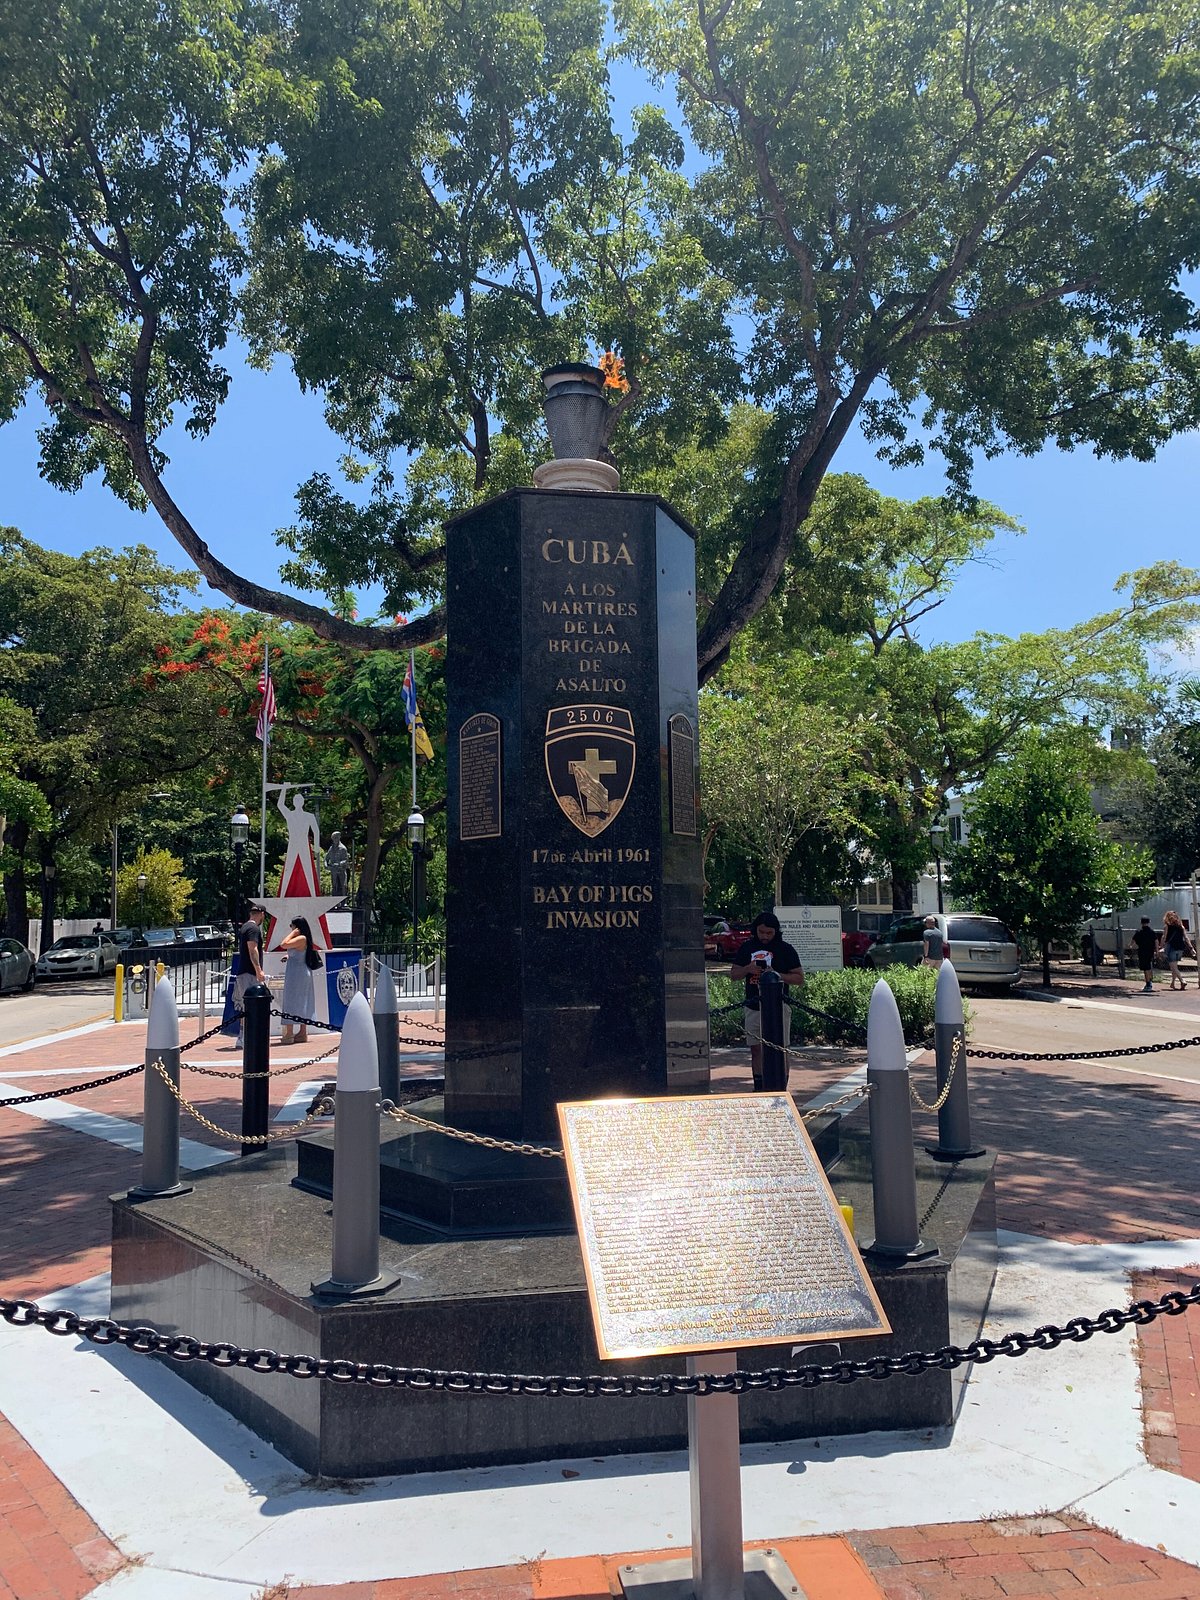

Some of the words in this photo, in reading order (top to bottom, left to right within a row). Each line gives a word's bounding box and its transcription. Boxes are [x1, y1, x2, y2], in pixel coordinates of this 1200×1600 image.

[542, 538, 634, 566] CUBA
[564, 583, 576, 595] A
[582, 583, 615, 596] LOS
[542, 601, 637, 616] MARTIRES
[564, 620, 587, 634] DE
[594, 622, 615, 634] LA
[549, 640, 632, 654] BRIGADA
[580, 659, 602, 672] DE
[556, 678, 626, 692] ASALTO
[566, 709, 614, 724] 2506
[532, 849, 549, 863] 17
[572, 848, 612, 863] Abril
[618, 848, 650, 862] 1961
[533, 886, 573, 903] BAY
[578, 886, 605, 903] OF
[609, 886, 653, 903] PIGS
[546, 910, 640, 928] INVASION
[709, 1310, 730, 1319] CITY
